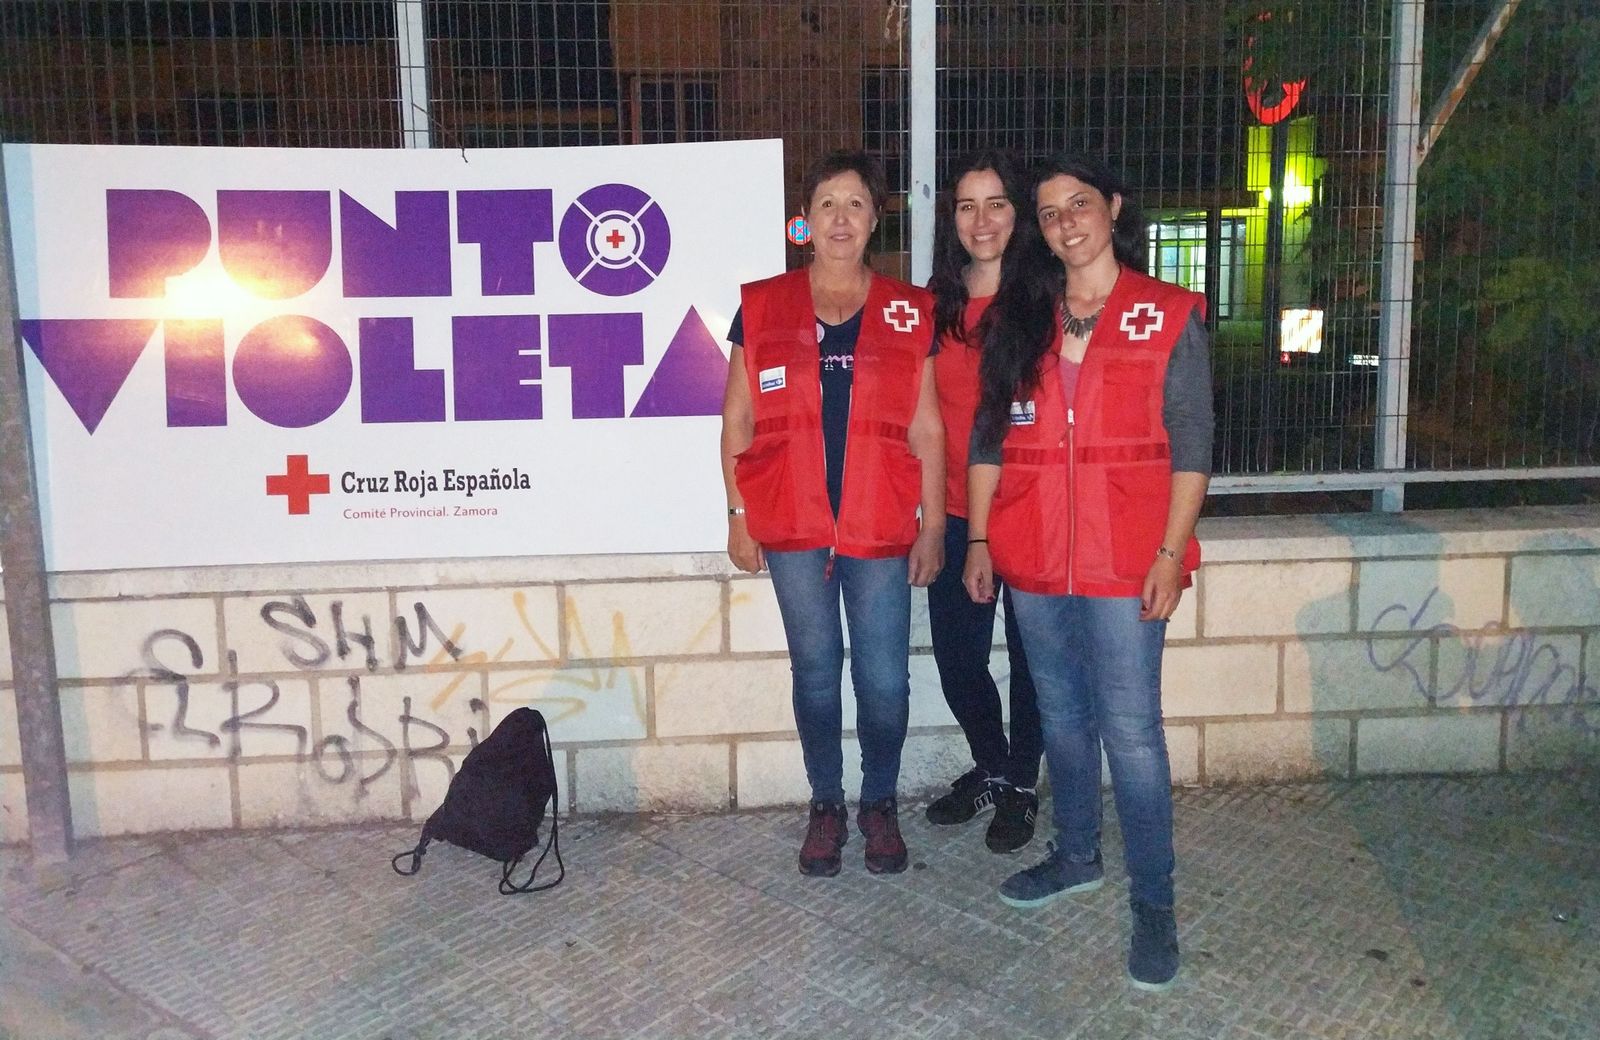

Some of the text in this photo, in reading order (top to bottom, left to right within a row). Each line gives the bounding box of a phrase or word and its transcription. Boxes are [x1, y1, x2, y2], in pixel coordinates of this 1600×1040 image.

[106, 183, 671, 298] PUNTO
[21, 304, 730, 436] VIOLETA
[341, 467, 531, 498] Cruz Roja Española
[343, 505, 498, 520] Comité Provincial. Zamora
